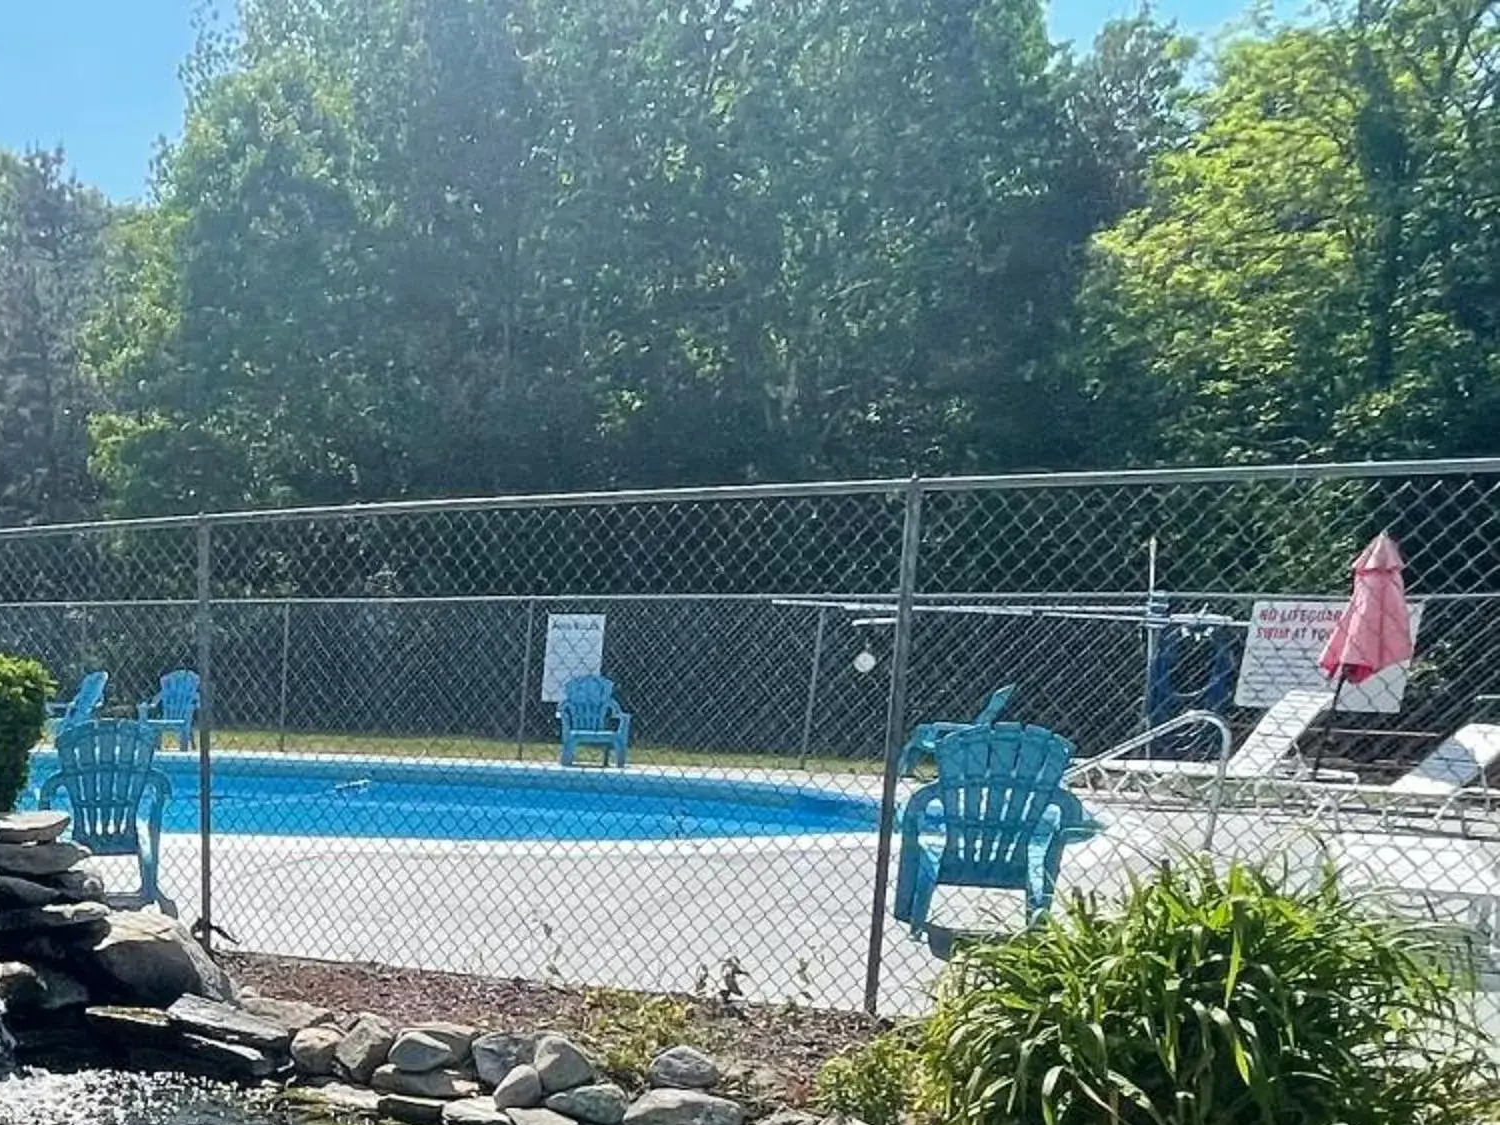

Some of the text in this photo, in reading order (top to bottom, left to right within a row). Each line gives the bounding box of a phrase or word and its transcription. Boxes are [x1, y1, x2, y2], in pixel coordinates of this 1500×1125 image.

[1259, 608, 1343, 623] NO LIFEGUAR
[1291, 626, 1307, 640] AT
